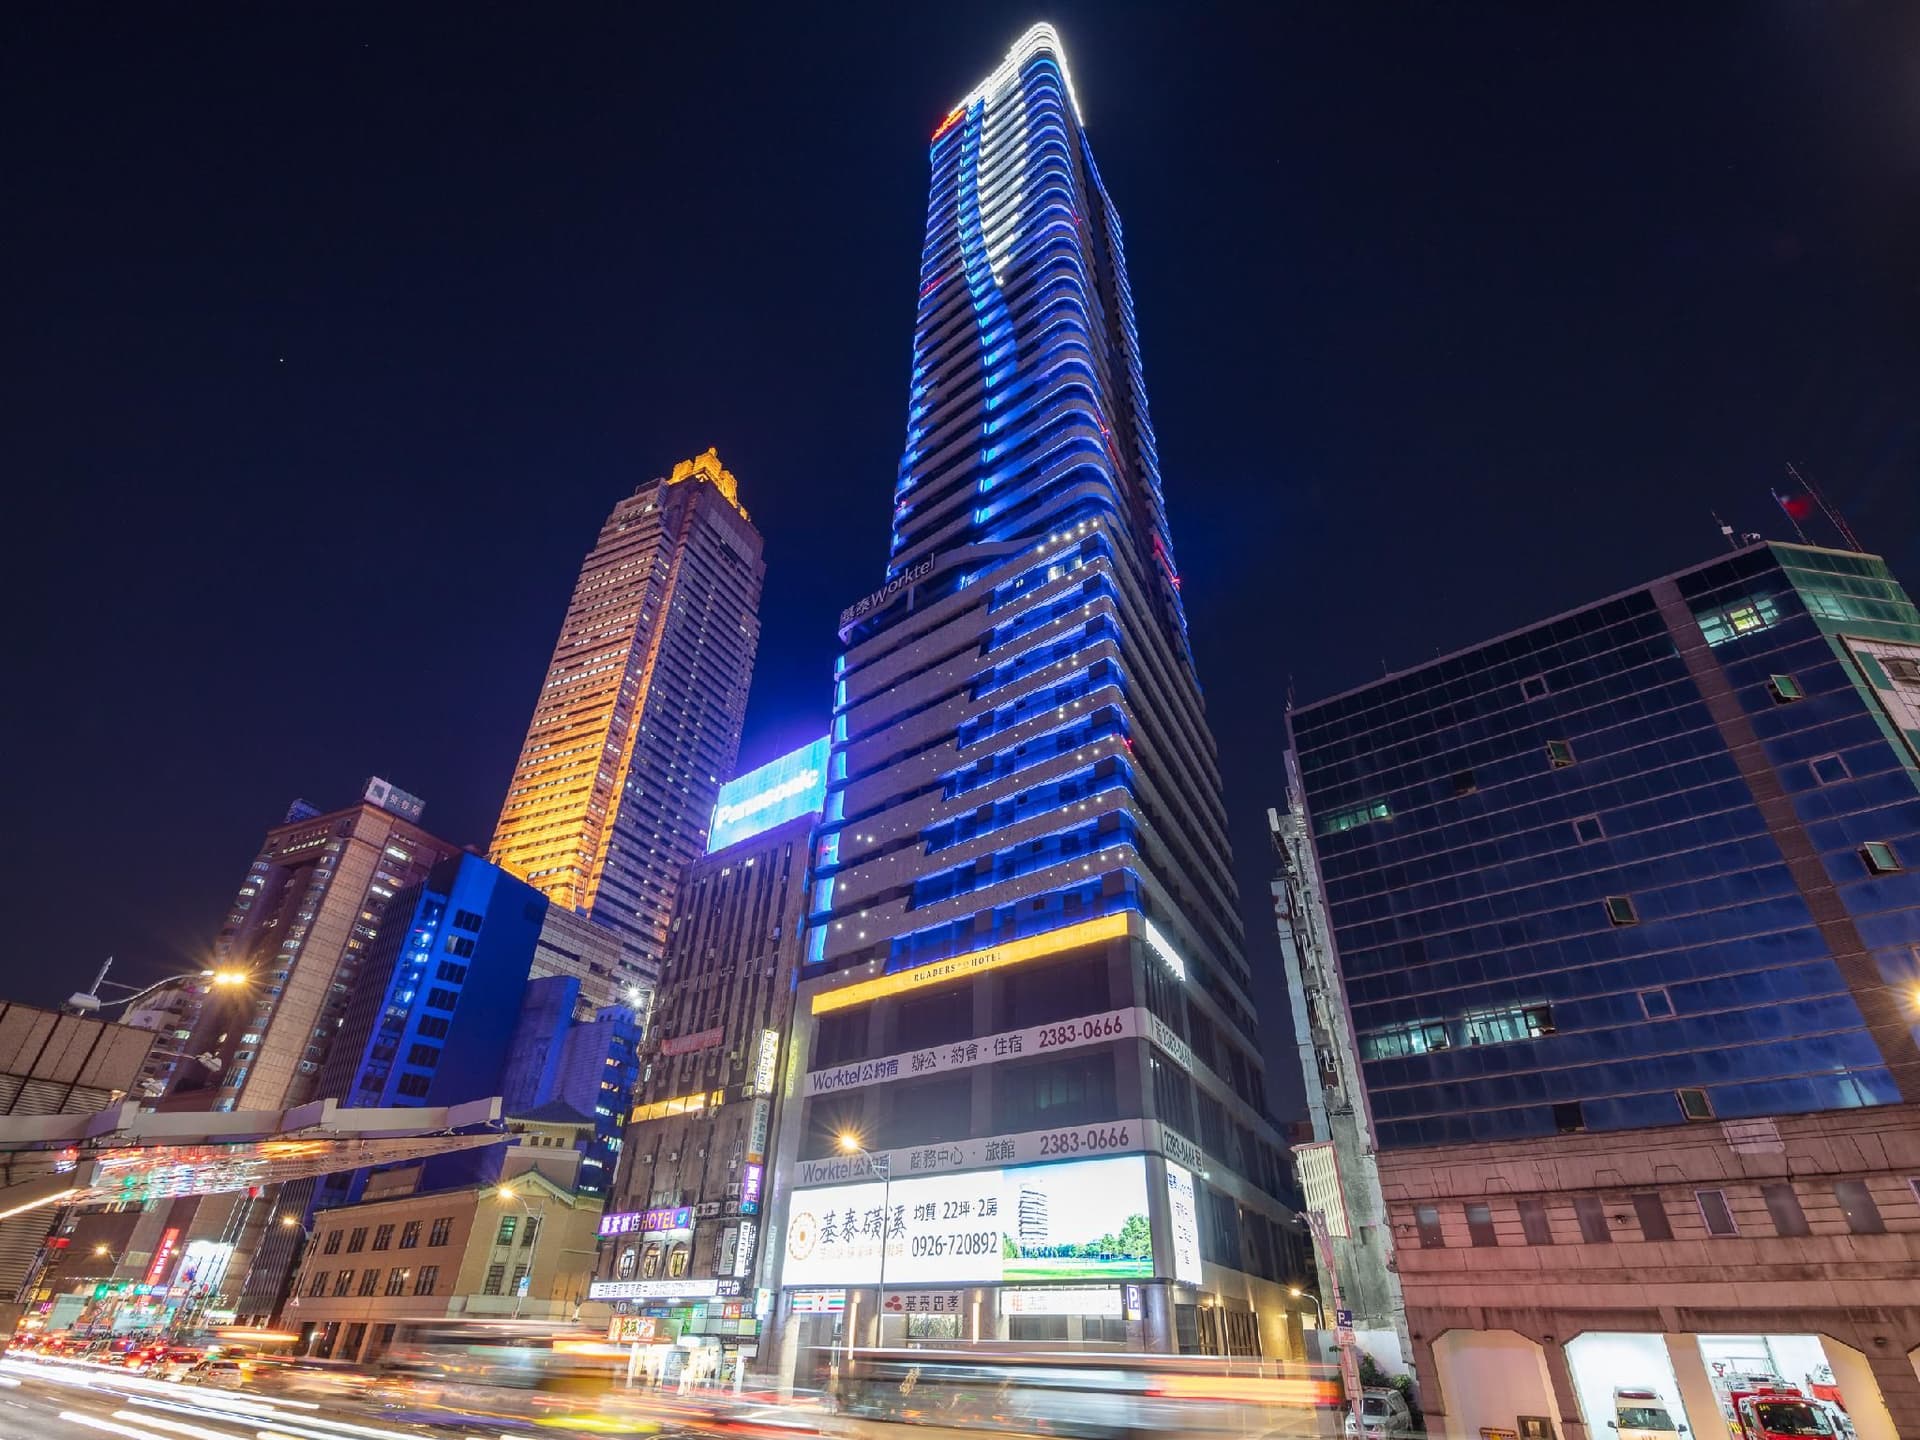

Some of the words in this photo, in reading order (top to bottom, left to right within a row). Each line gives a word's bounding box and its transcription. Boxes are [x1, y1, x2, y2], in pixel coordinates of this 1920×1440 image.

[1039, 1016, 1123, 1048] 2383-0666
[1040, 1127, 1129, 1155] 2383-0666
[640, 1212, 676, 1230] HOTEL
[912, 1232, 998, 1257] 0926-720892
